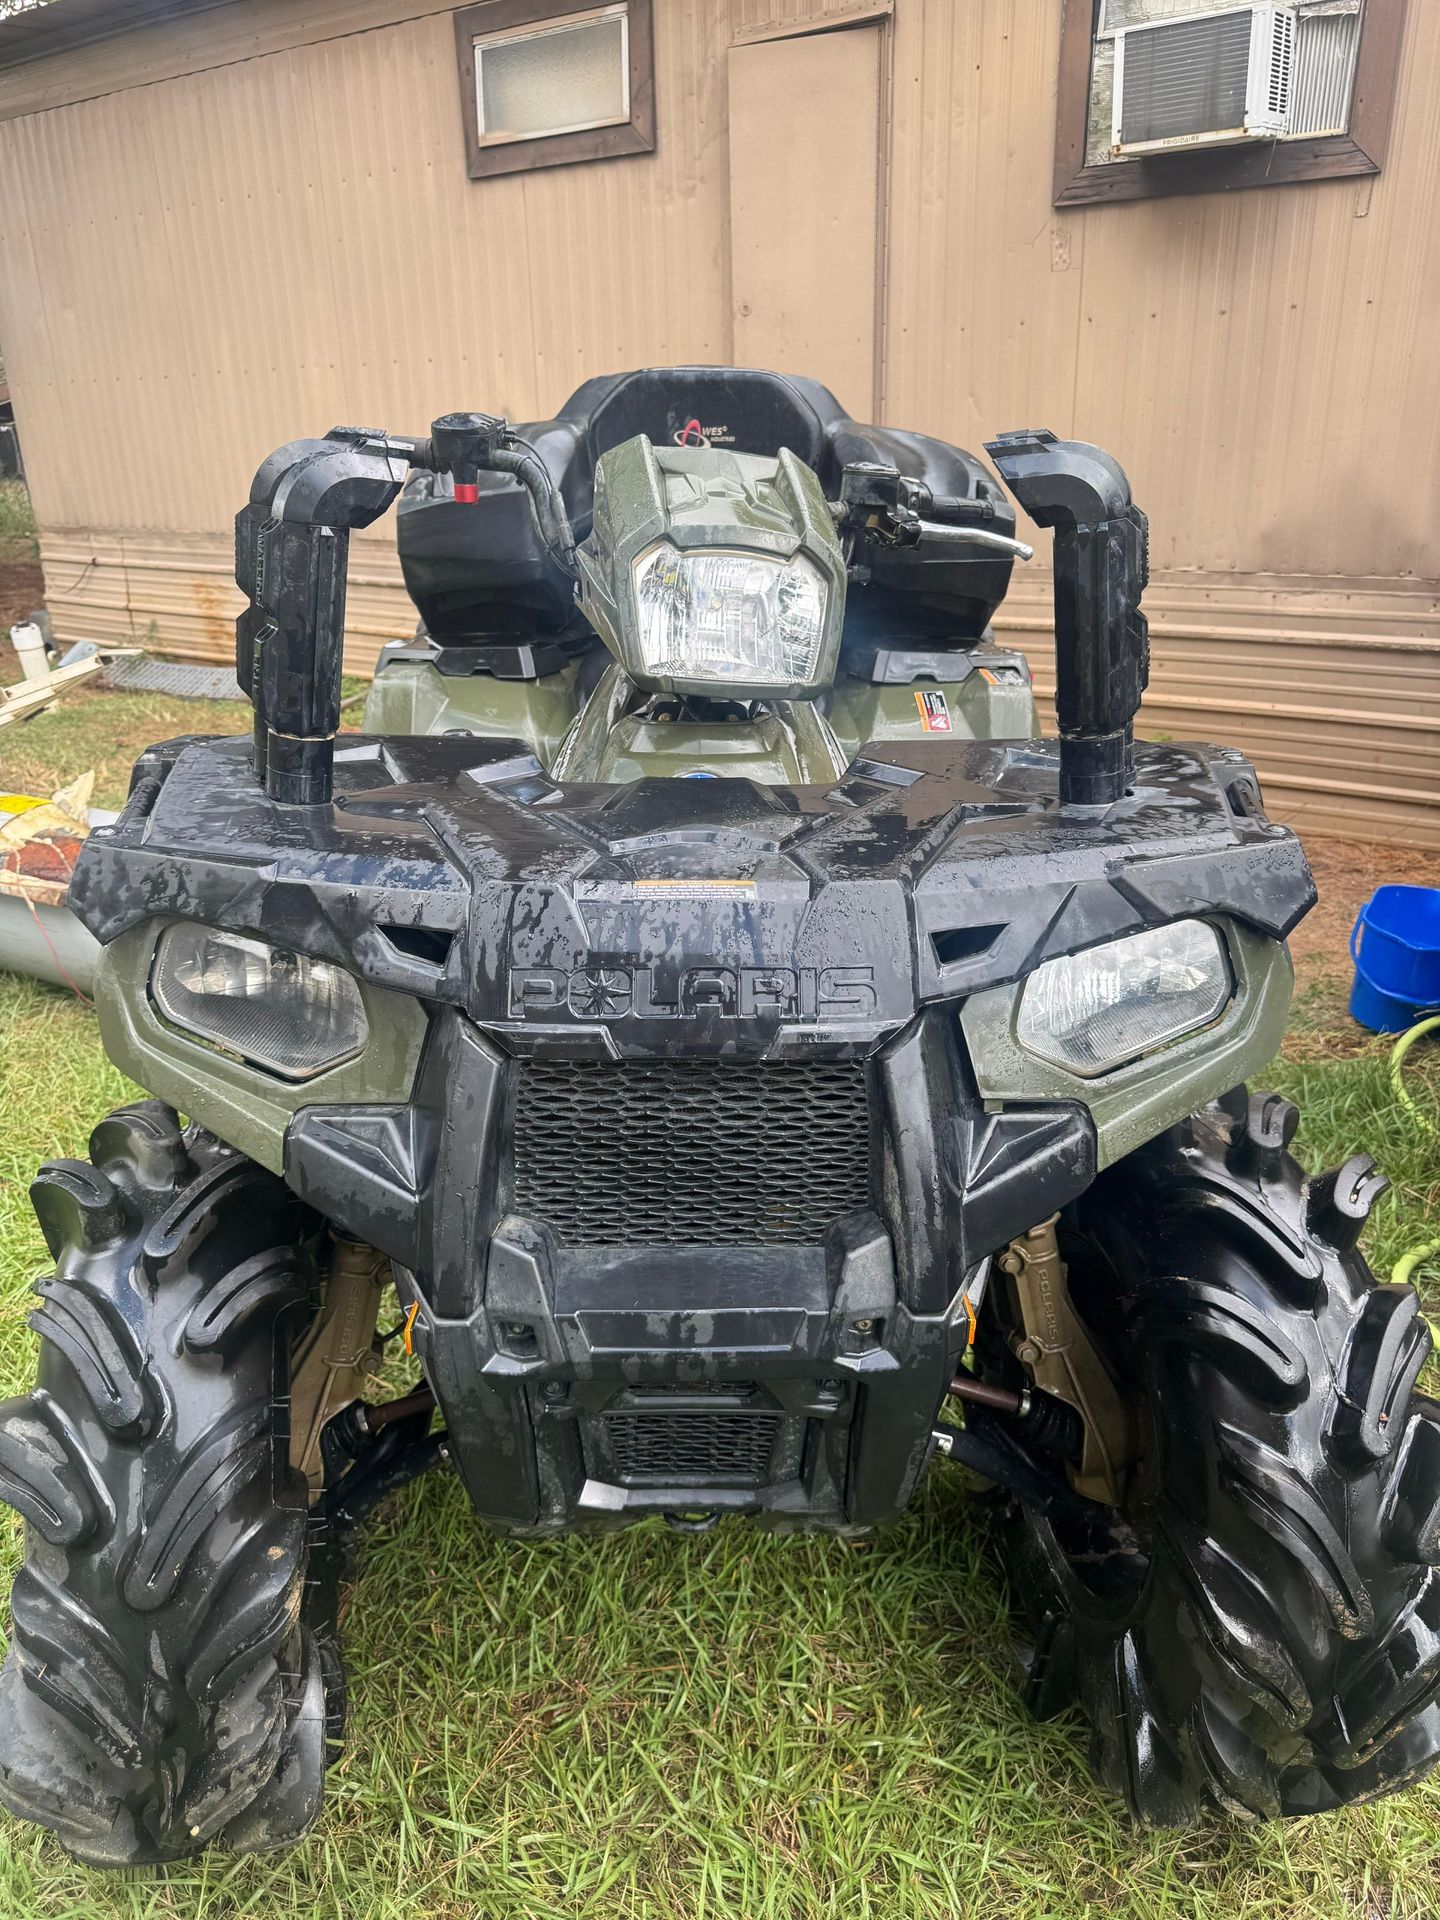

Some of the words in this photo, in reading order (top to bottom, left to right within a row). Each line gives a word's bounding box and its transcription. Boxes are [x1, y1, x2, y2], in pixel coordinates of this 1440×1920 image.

[1162, 135, 1201, 146] FRIGIDAIRE
[508, 967, 878, 1019] POLARIS
[1037, 1268, 1060, 1340] POLARIS
